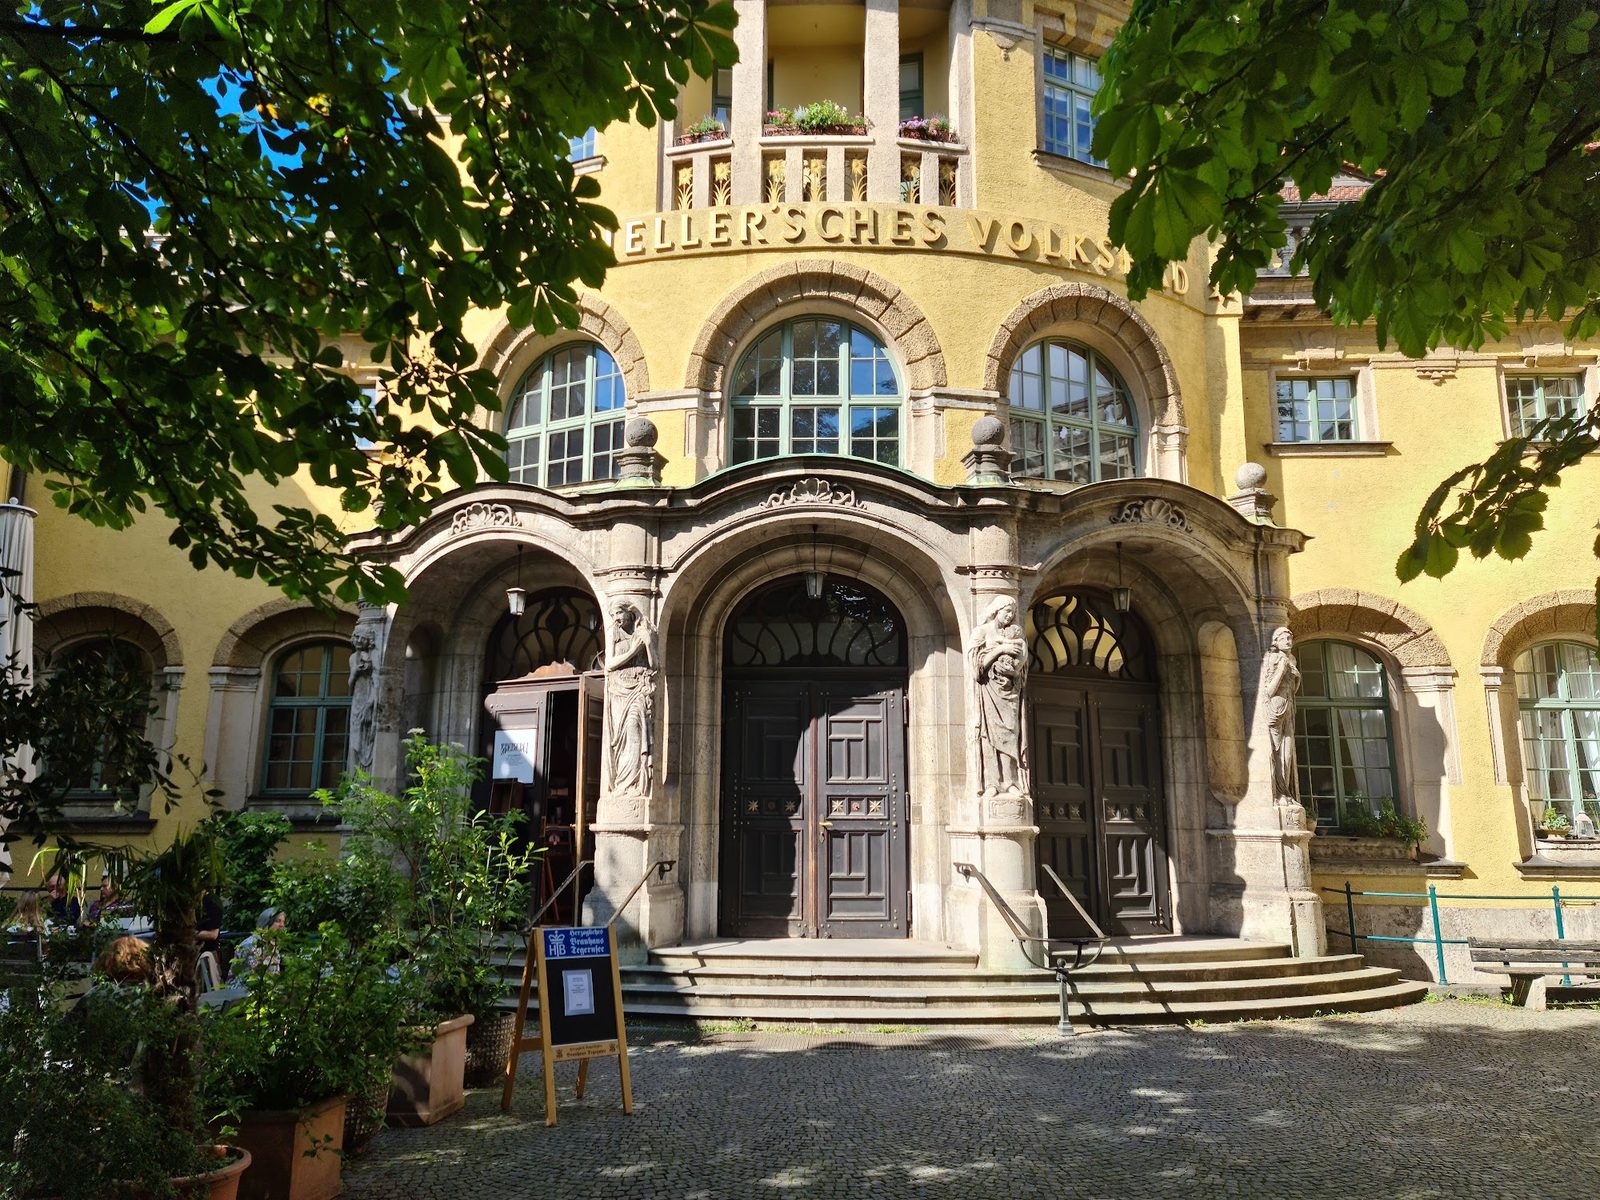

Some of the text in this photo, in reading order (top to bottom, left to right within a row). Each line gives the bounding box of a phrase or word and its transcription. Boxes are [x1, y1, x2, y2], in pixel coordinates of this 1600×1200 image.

[604, 204, 1190, 295] ELLER'SCHES VOLKSD
[570, 937, 605, 946] Brauhaus
